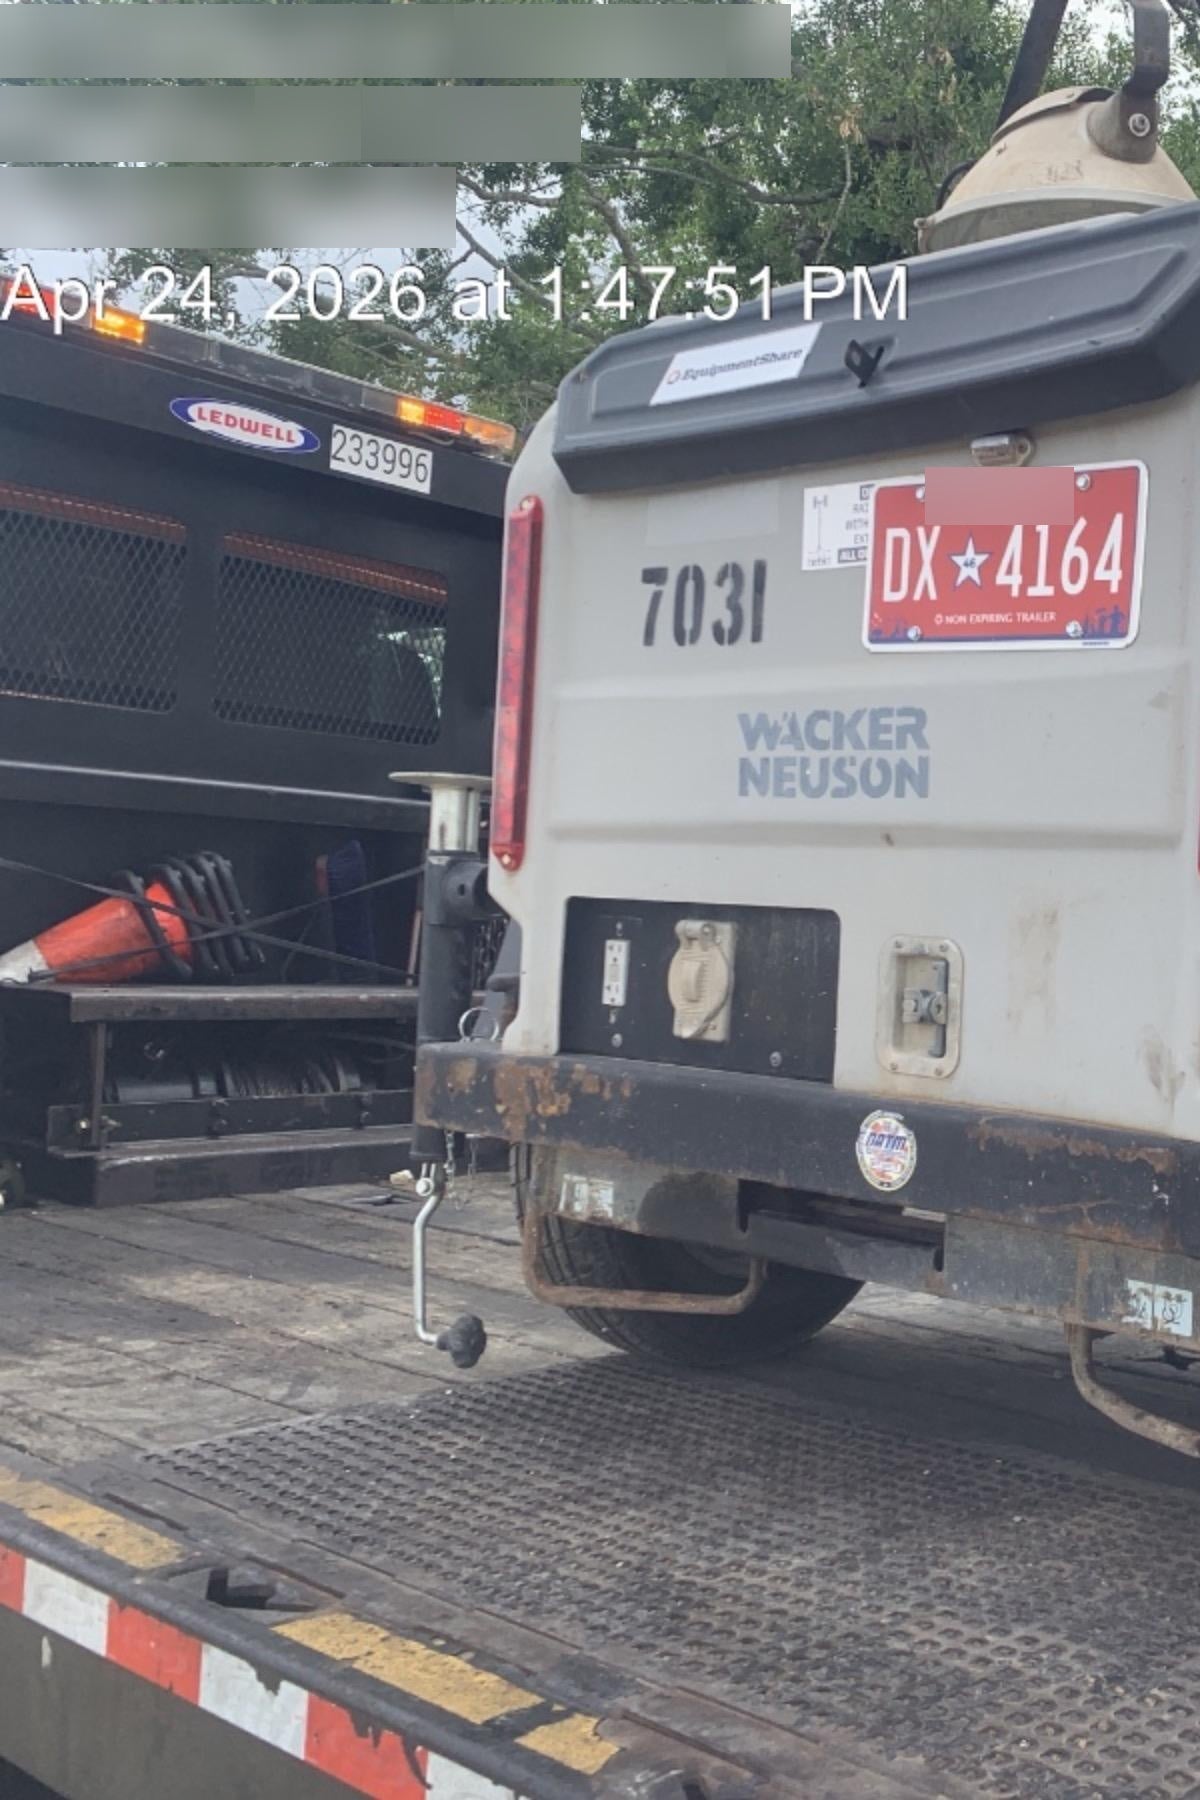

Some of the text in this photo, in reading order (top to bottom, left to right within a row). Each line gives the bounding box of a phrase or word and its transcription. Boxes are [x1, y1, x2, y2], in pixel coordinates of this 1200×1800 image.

[681, 348, 803, 382] EquipmentShare
[197, 407, 296, 445] LEDWELL
[331, 428, 429, 483] 233996
[882, 525, 941, 602] DX
[995, 513, 1123, 598] 4164
[641, 559, 767, 647] 7031
[945, 611, 1057, 625] NON EXPIRING TRAILER
[737, 707, 930, 752] WACKER
[737, 756, 930, 799] NEUSON
